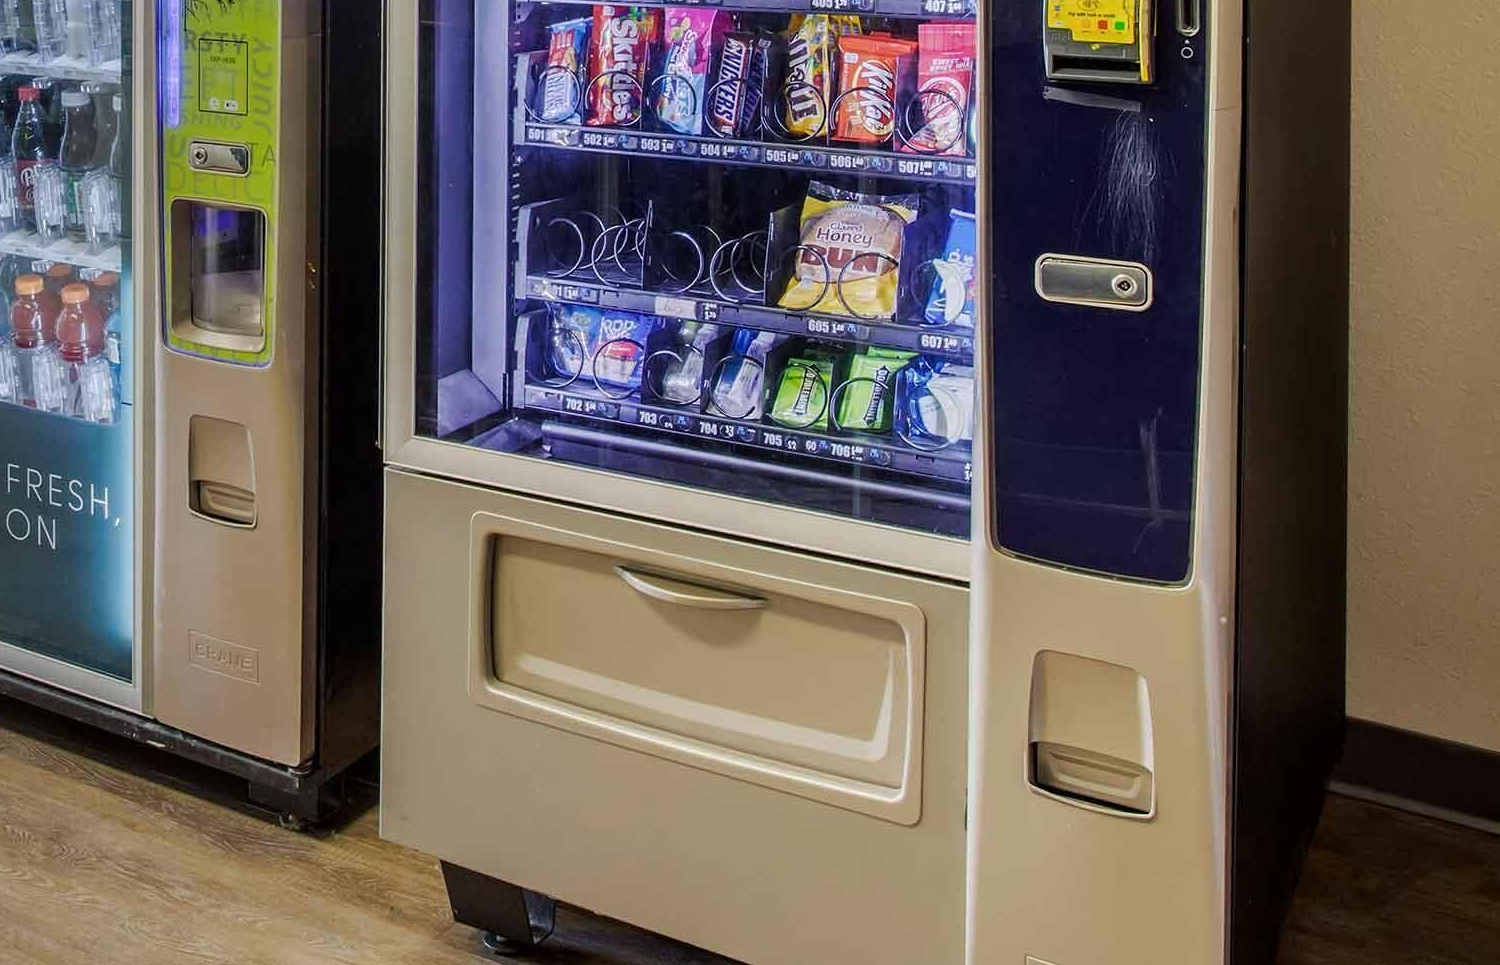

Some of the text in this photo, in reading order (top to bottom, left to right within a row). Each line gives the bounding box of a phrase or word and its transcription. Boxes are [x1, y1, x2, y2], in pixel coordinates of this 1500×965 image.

[924, 0, 946, 13] 407
[611, 17, 638, 121] Skittles
[715, 37, 744, 123] SNICKERS
[528, 128, 546, 140] 501
[583, 133, 602, 145] 502
[641, 138, 660, 150] 503
[700, 143, 721, 156] 504
[766, 149, 787, 162] 505
[830, 155, 851, 168] 506
[899, 160, 920, 174] 507
[816, 227, 873, 248] Honey
[800, 244, 878, 273] BUN
[808, 319, 829, 333] 605
[921, 334, 943, 348] 607
[566, 398, 583, 412] 702
[639, 410, 658, 424] 703
[700, 421, 718, 435] 704
[763, 432, 783, 446] 705
[830, 443, 851, 458] 706
[6, 462, 121, 527] FRESH,
[5, 507, 57, 550] ON
